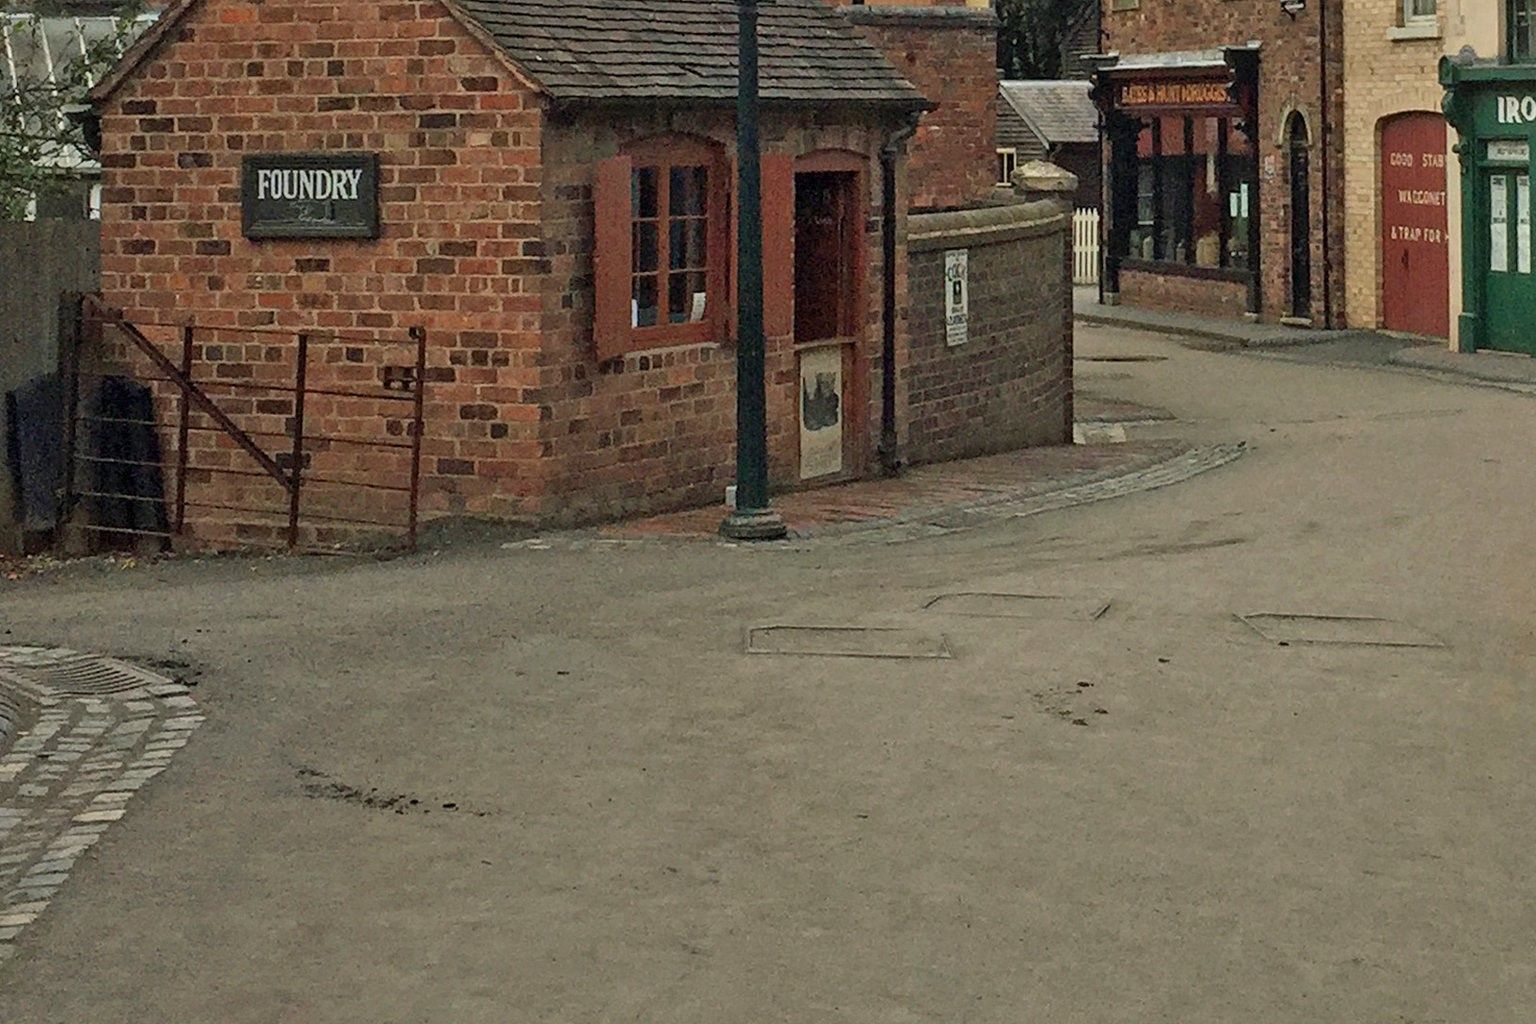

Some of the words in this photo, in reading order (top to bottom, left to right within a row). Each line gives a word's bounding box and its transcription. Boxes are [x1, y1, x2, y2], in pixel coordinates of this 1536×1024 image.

[1389, 152, 1414, 168] GOOD
[256, 168, 364, 200] FOUNDRY
[1398, 225, 1421, 242] TRAP
[1423, 228, 1441, 243] FOR
